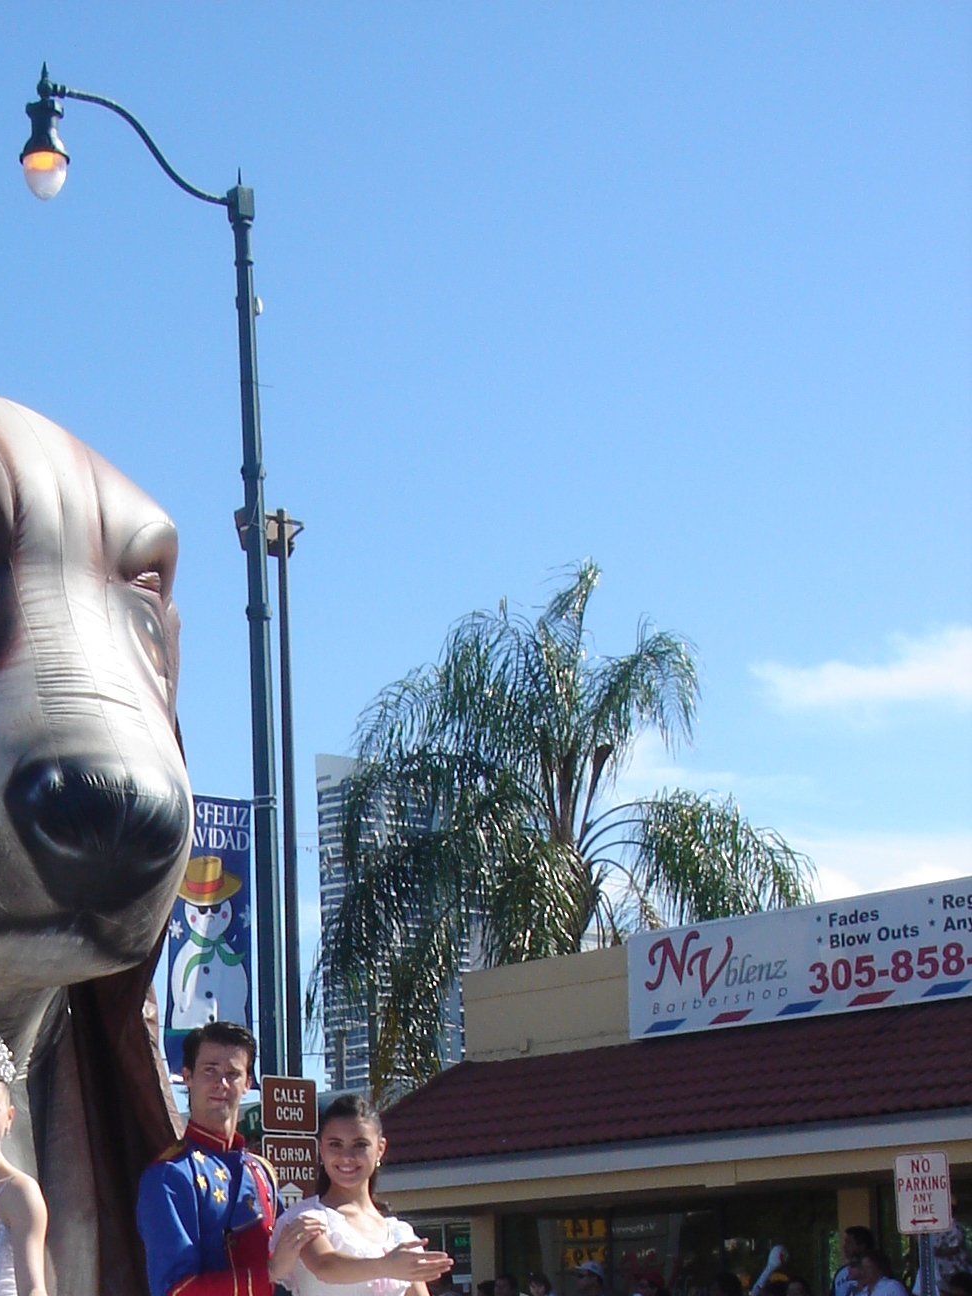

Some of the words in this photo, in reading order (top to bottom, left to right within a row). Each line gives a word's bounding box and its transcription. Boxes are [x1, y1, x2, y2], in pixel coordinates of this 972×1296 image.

[196, 801, 249, 828] FELIZ
[193, 826, 250, 851] VIDAD
[829, 909, 879, 928] Fades
[829, 932, 871, 949] Blow
[877, 924, 920, 941] Outs
[652, 987, 788, 1015] Barbershop
[273, 1088, 306, 1104] CALLE
[276, 1106, 304, 1121] OCHO
[266, 1143, 312, 1162] FLORIDA
[274, 1166, 315, 1180] ERITAGE
[910, 1158, 931, 1174] NO
[897, 1175, 947, 1192] PARKING
[913, 1193, 933, 1203] ANY
[912, 1204, 935, 1215] TIME
